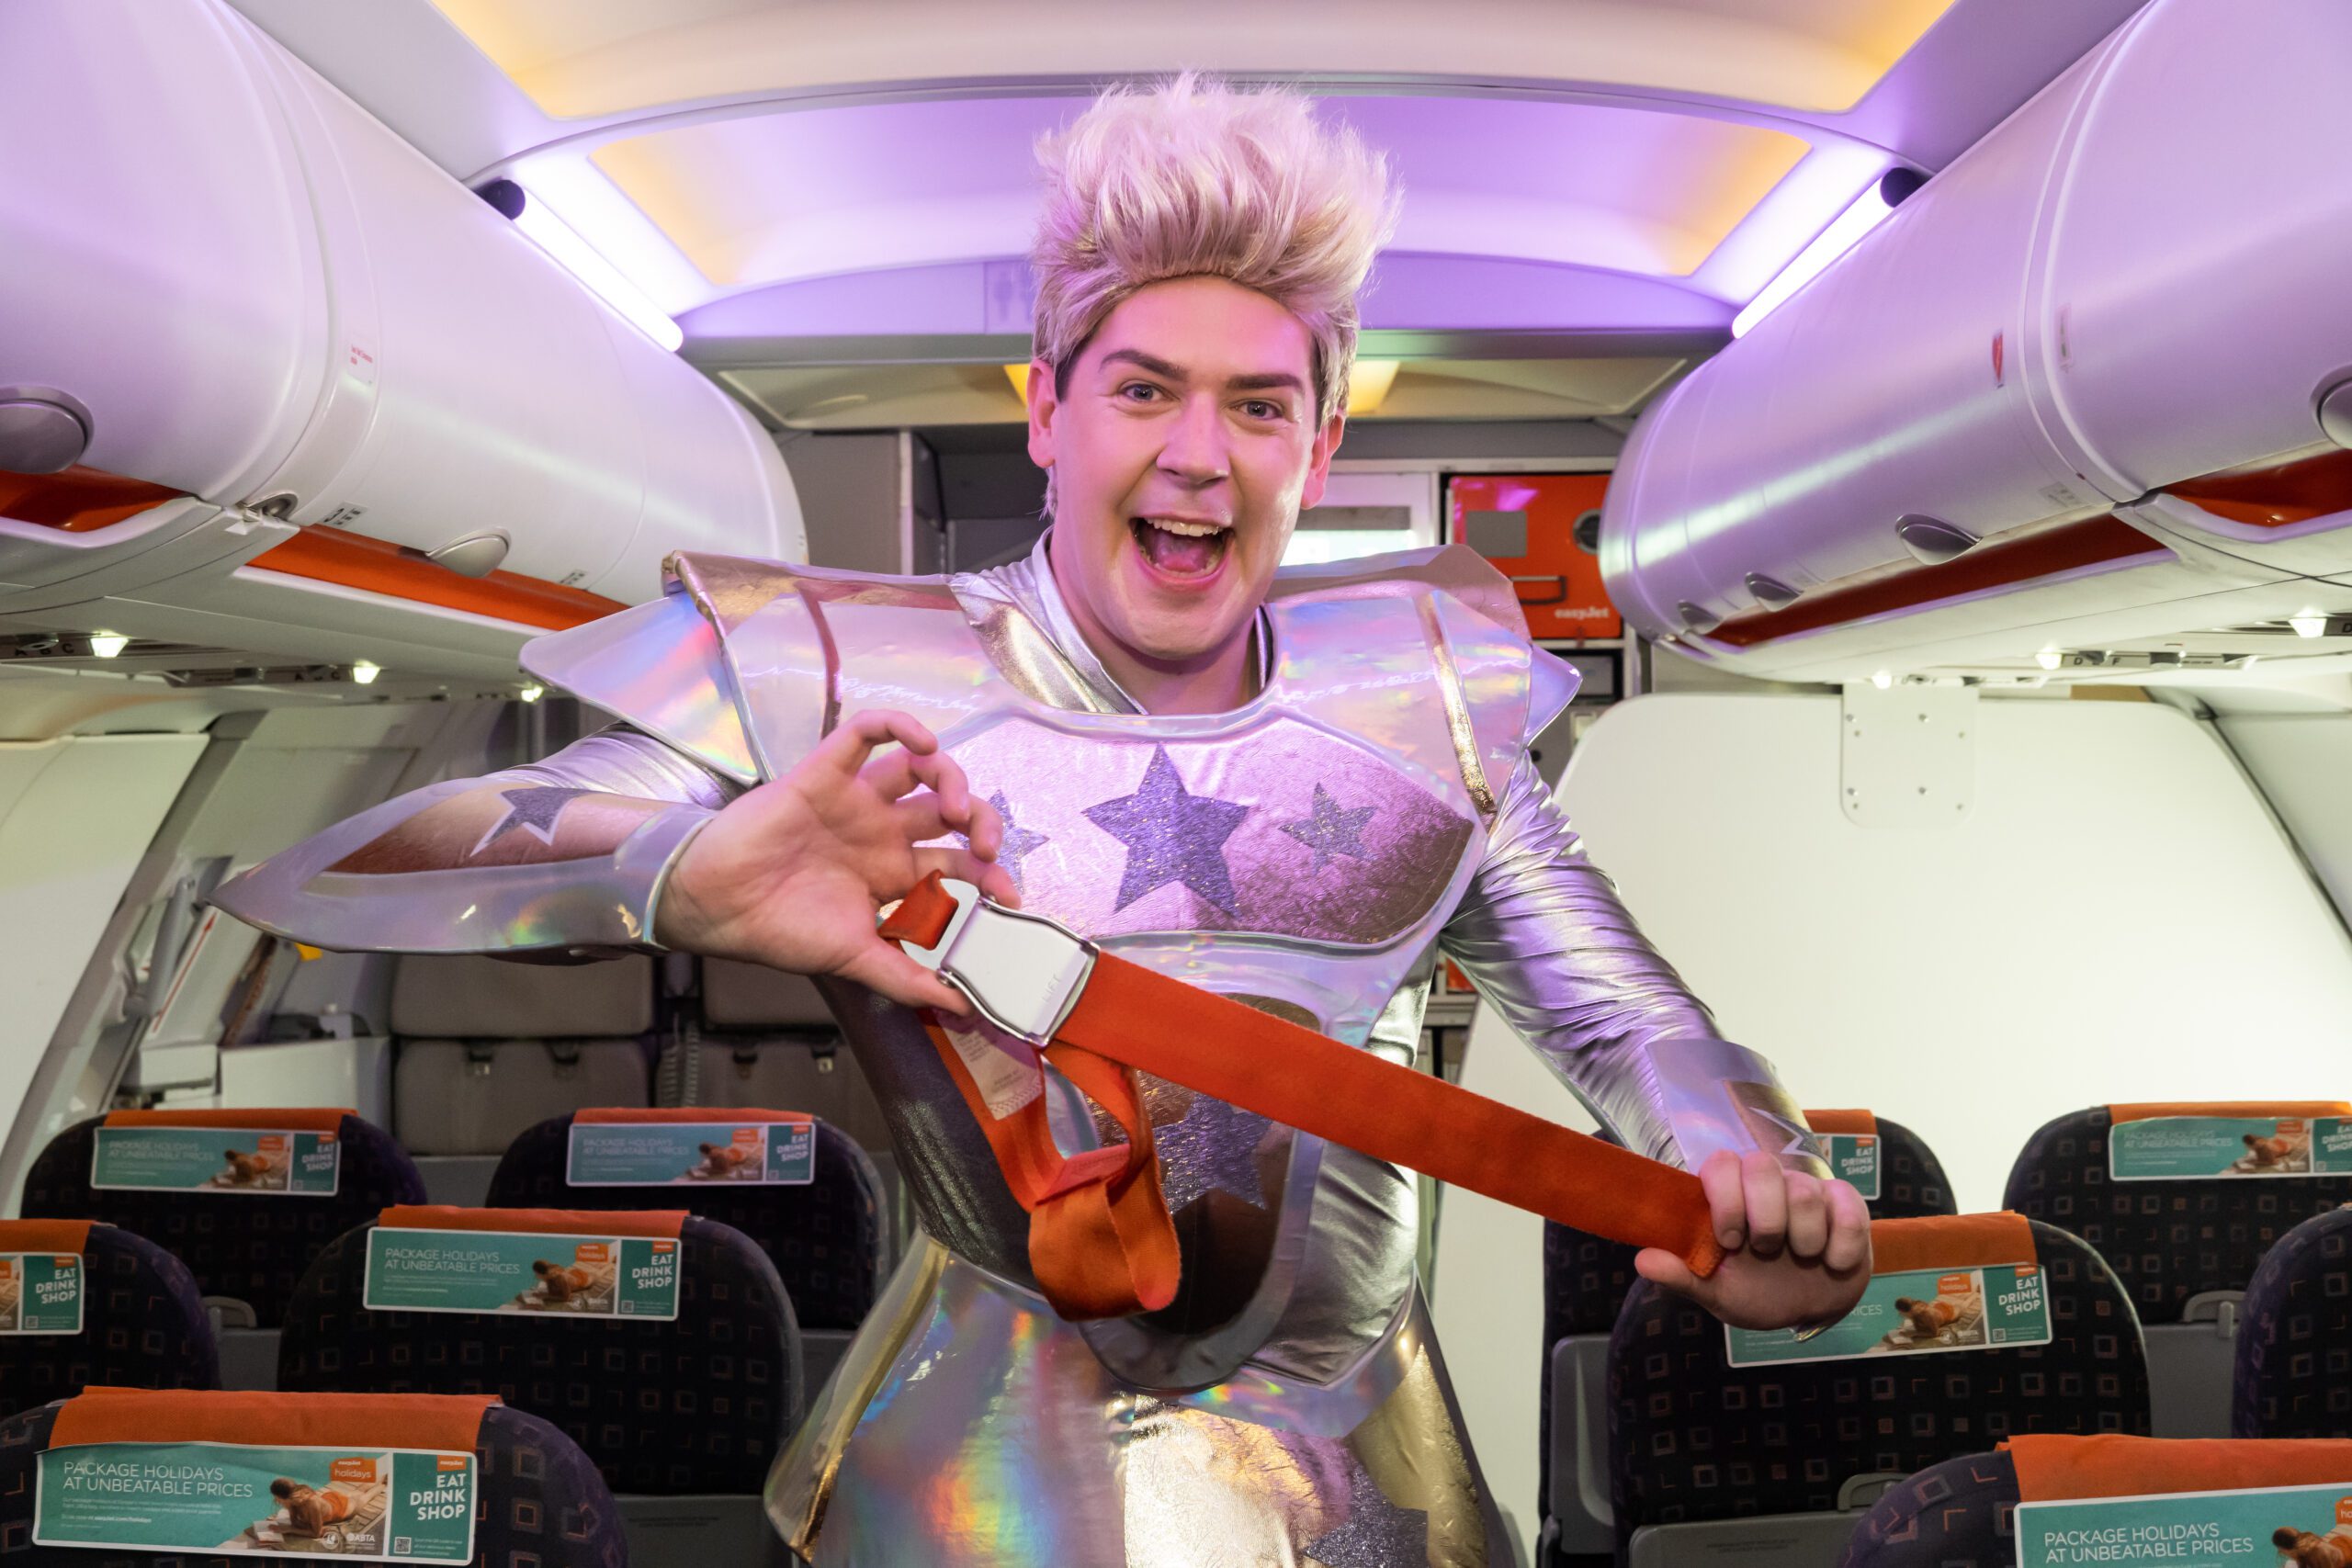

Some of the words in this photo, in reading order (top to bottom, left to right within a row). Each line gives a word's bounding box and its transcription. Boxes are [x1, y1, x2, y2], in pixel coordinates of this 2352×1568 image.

[1555, 607, 1610, 620] easyJet
[62, 643, 74, 654] C
[2074, 657, 2084, 666] D
[2112, 657, 2121, 666] F
[294, 672, 304, 682] A
[331, 671, 341, 681] C
[791, 1134, 808, 1144] EAT
[317, 1144, 334, 1153] EAT
[776, 1144, 808, 1155] DRINK
[1856, 1147, 1873, 1156] EAT
[301, 1153, 334, 1164] DRINK
[781, 1151, 808, 1161] SHOP
[306, 1162, 334, 1172] SHOP
[1841, 1157, 1873, 1168] DRINK
[1846, 1165, 1873, 1176] SHOP
[385, 1248, 440, 1260] PACKAGE
[442, 1250, 500, 1262] HOLIDAYS
[651, 1254, 673, 1266] EAT
[384, 1259, 399, 1269] AT
[401, 1260, 479, 1272] UNBEATABLE
[480, 1263, 520, 1274] PRICES
[632, 1266, 673, 1279] DRINK
[55, 1268, 76, 1280] EAT
[36, 1280, 76, 1293] DRINK
[638, 1277, 673, 1290] SHOP
[2016, 1276, 2038, 1291] EAT
[41, 1291, 76, 1304] SHOP
[1998, 1288, 2040, 1306] DRINK
[2006, 1300, 2041, 1315] SHOP
[63, 1461, 141, 1477] PACKAGE
[144, 1465, 224, 1482] HOLIDAYS
[334, 1468, 372, 1479] holidays
[436, 1473, 467, 1488] EAT
[62, 1476, 83, 1491] AT
[86, 1478, 192, 1495] UNBEATABLE
[197, 1483, 254, 1498] PRICES
[410, 1488, 466, 1506] DRINK
[417, 1505, 466, 1521] SHOP
[355, 1533, 376, 1543] ABTA
[2044, 1528, 2128, 1548] PACKAGE
[2132, 1522, 2220, 1541] HOLIDAYS
[2045, 1548, 2066, 1564] AT
[2071, 1541, 2188, 1562] UNBEATABLE
[2192, 1537, 2254, 1555] PRICES
